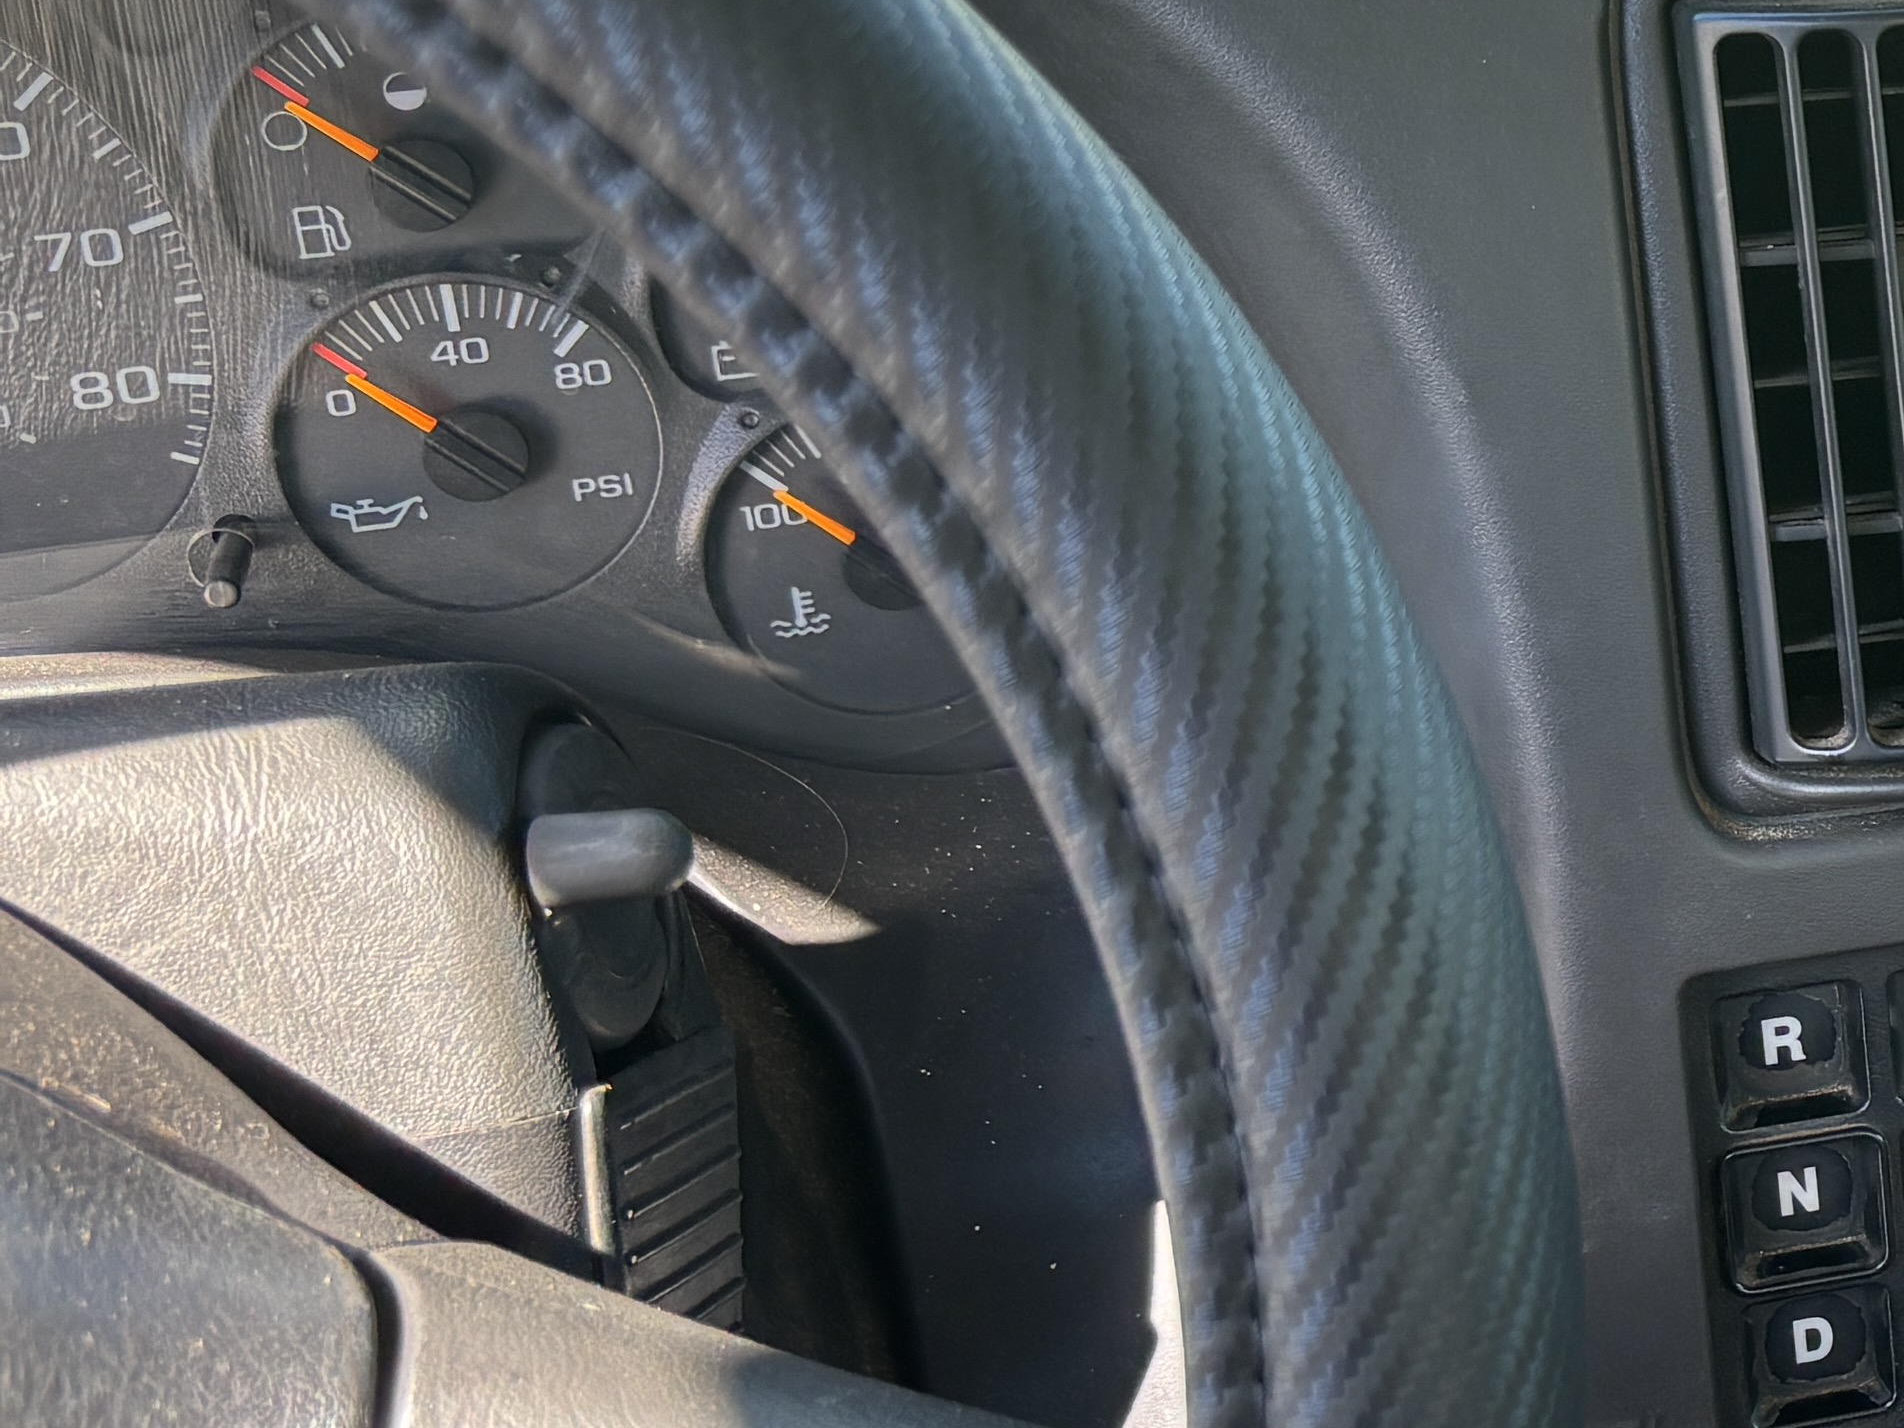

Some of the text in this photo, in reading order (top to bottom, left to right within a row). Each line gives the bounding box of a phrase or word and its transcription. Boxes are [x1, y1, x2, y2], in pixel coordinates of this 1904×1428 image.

[33, 228, 124, 272] 70
[430, 337, 490, 367] 40
[69, 365, 160, 410] 80
[553, 359, 612, 390] 80
[325, 389, 357, 417] 0
[572, 472, 634, 502] PSI
[739, 503, 808, 531] 100
[1760, 1014, 1807, 1066] R
[1777, 1165, 1821, 1217] N
[1792, 1316, 1835, 1365] D
